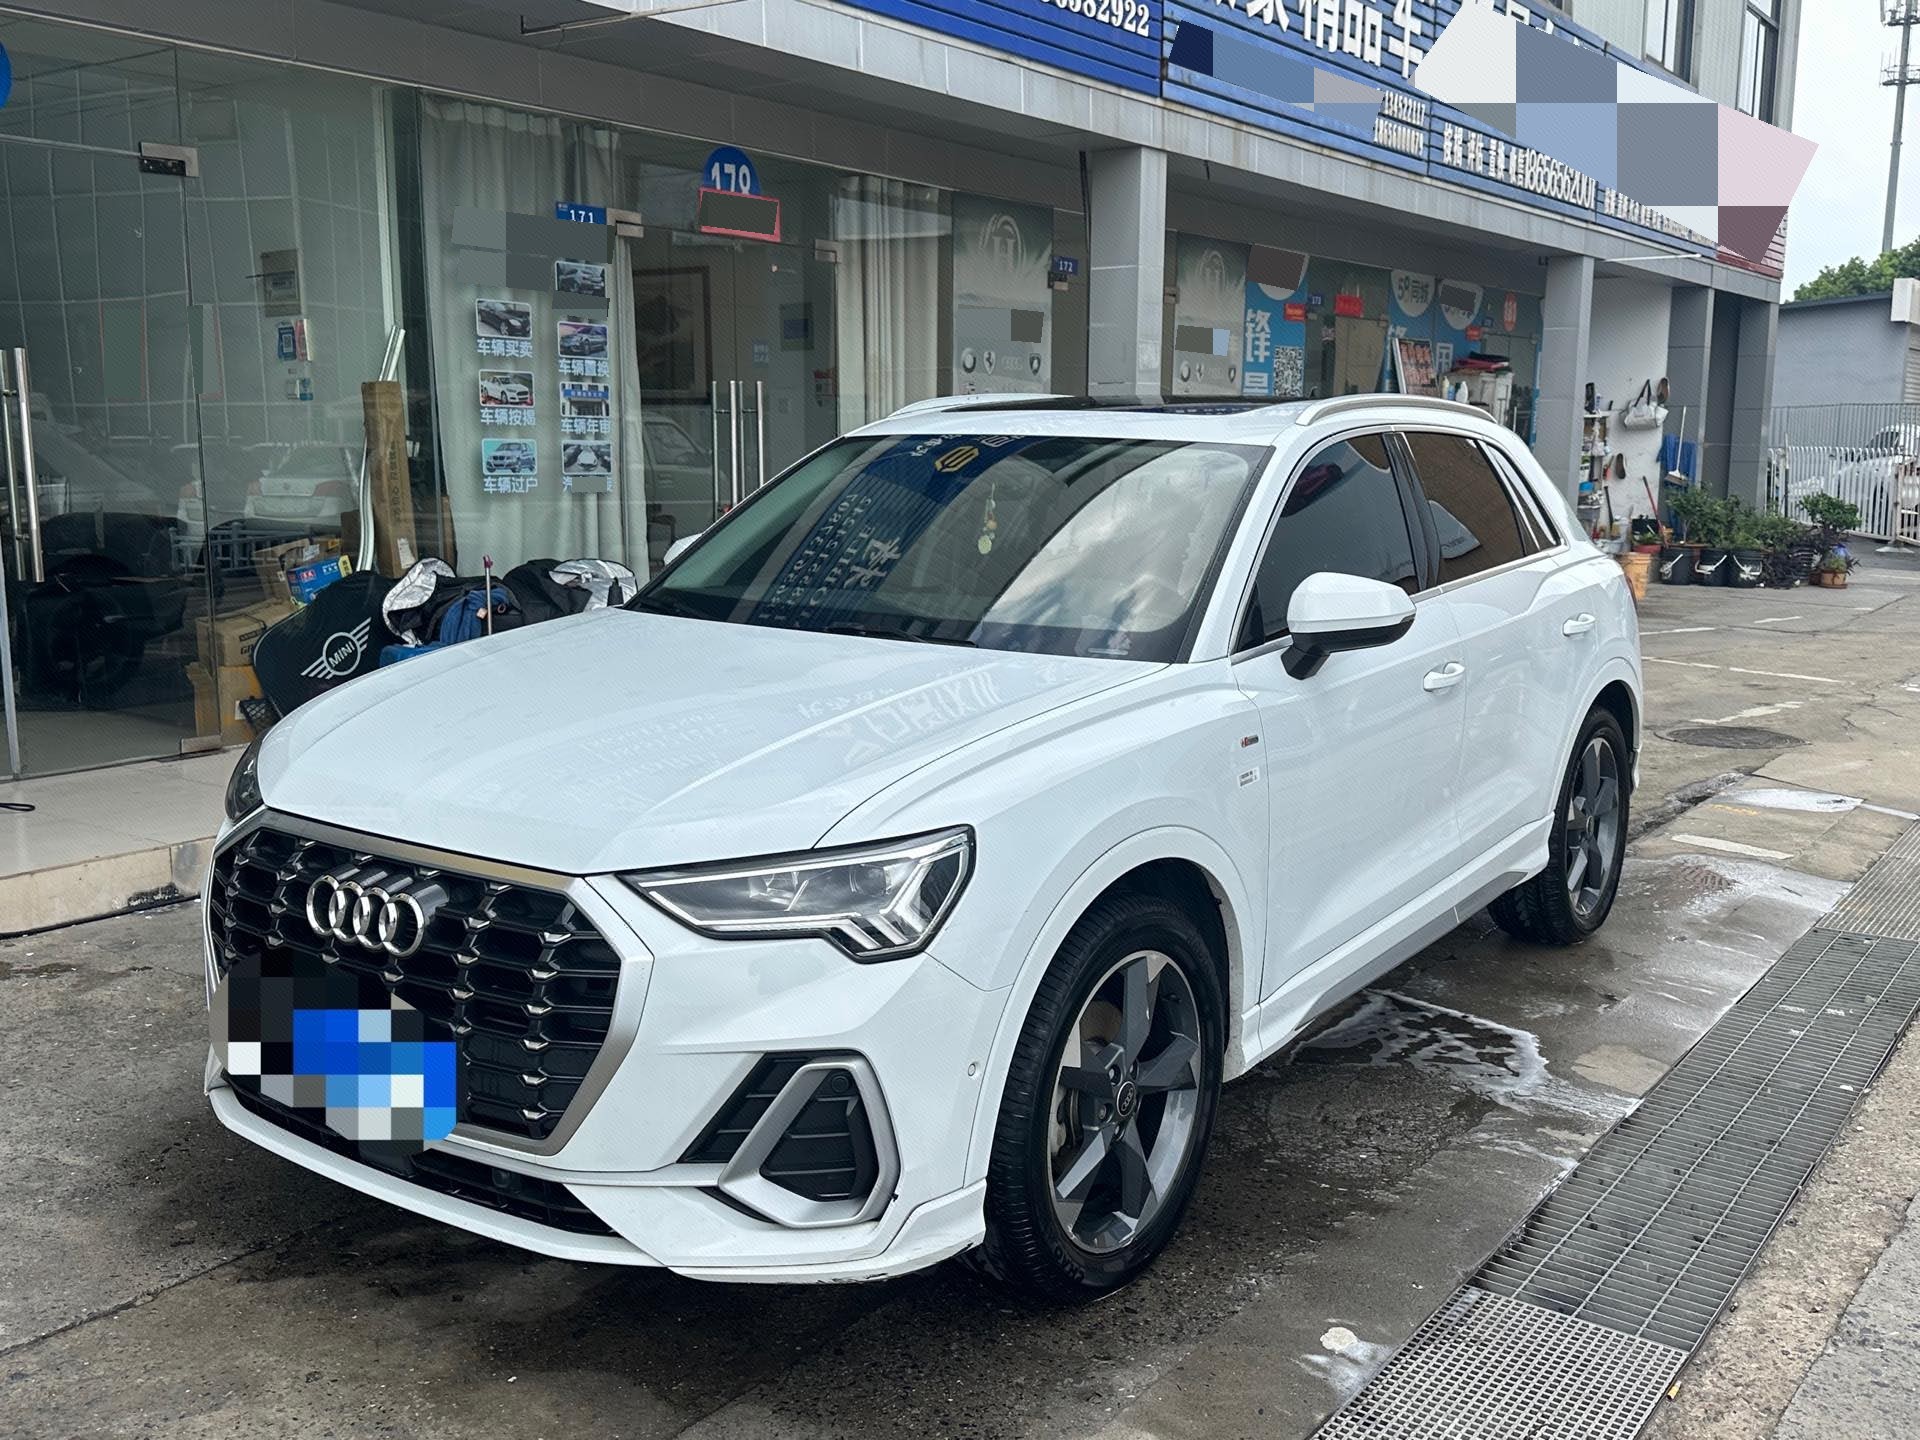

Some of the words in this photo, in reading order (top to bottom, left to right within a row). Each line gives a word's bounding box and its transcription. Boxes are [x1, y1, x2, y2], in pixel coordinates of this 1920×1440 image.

[1042, 0, 1150, 37] 82922
[569, 209, 595, 224] 171
[1059, 260, 1073, 272] 172
[476, 338, 533, 358] 车辆买卖
[558, 359, 609, 377] 车辆置换
[480, 407, 536, 426] 车辆按揭
[560, 418, 611, 435] 车辆年审
[483, 476, 538, 494] 车辆过户
[328, 641, 356, 667] MINI
